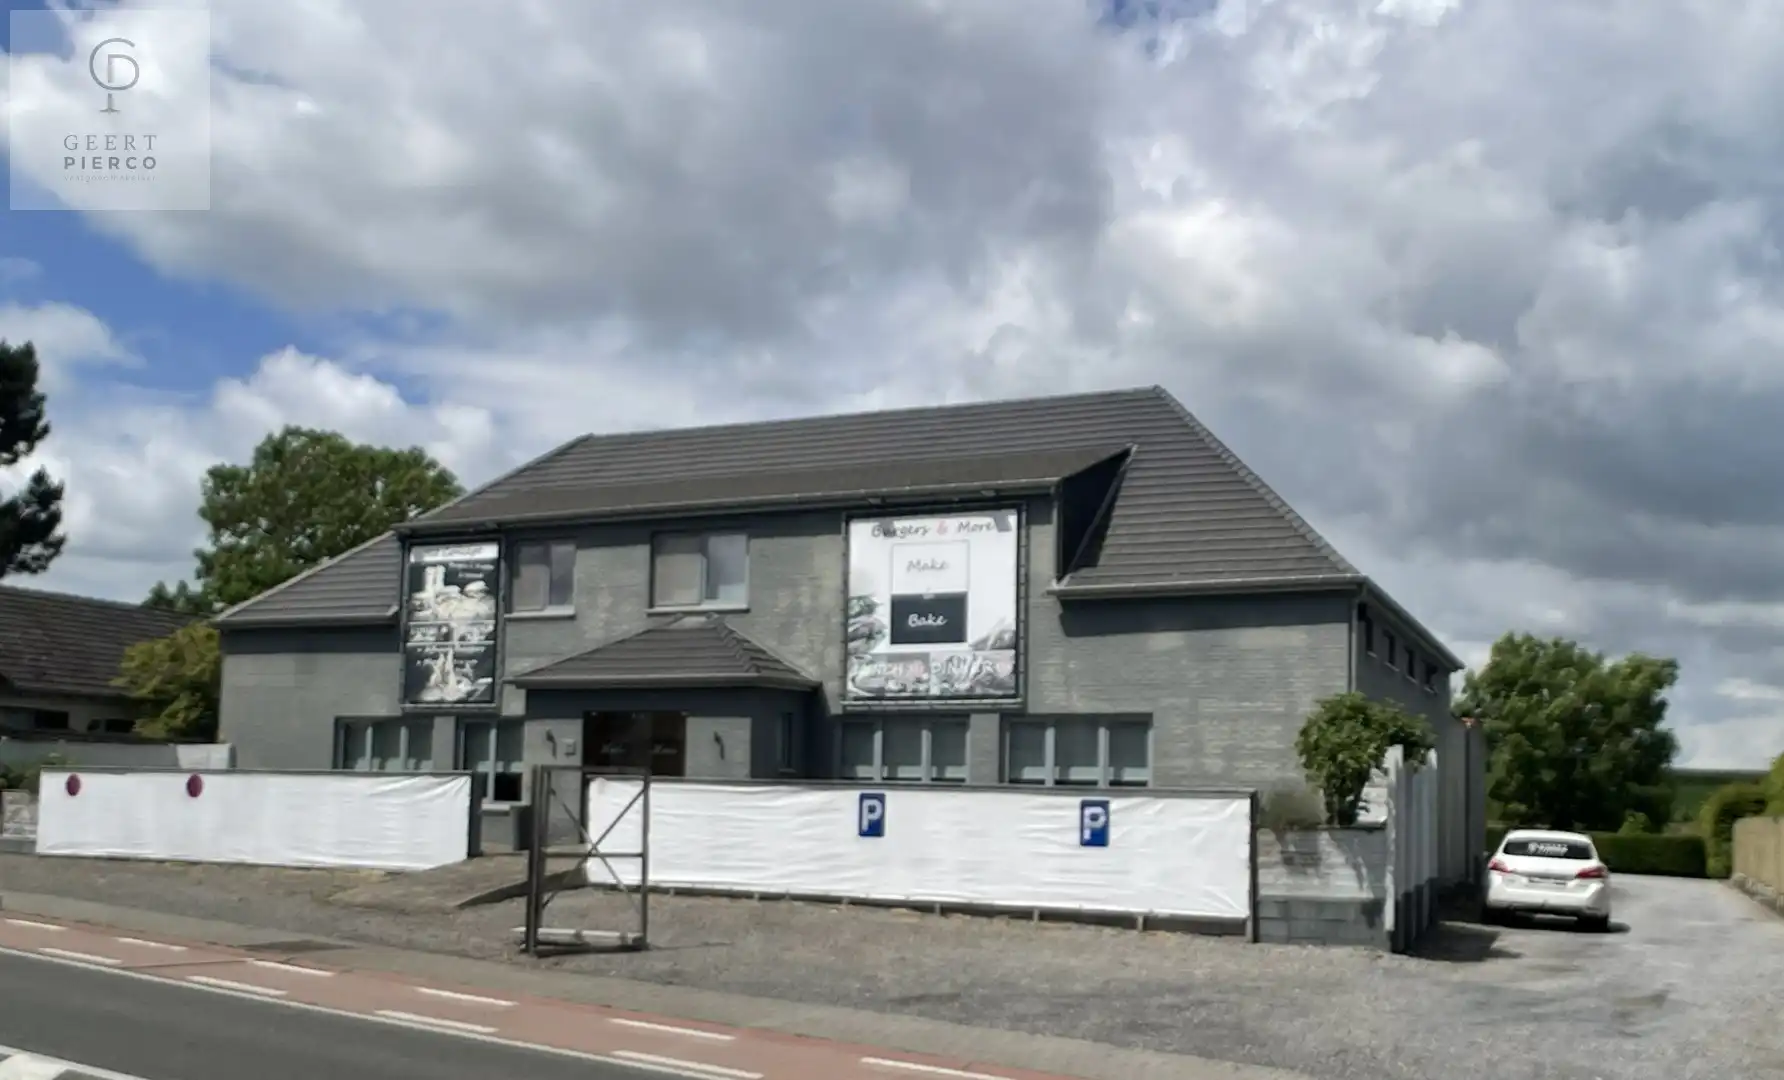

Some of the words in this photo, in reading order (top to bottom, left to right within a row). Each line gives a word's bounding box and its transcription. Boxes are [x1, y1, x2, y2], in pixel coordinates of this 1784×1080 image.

[906, 558, 949, 573] Make
[908, 613, 949, 628] Bake
[862, 799, 883, 832] P
[1083, 806, 1106, 840] P
